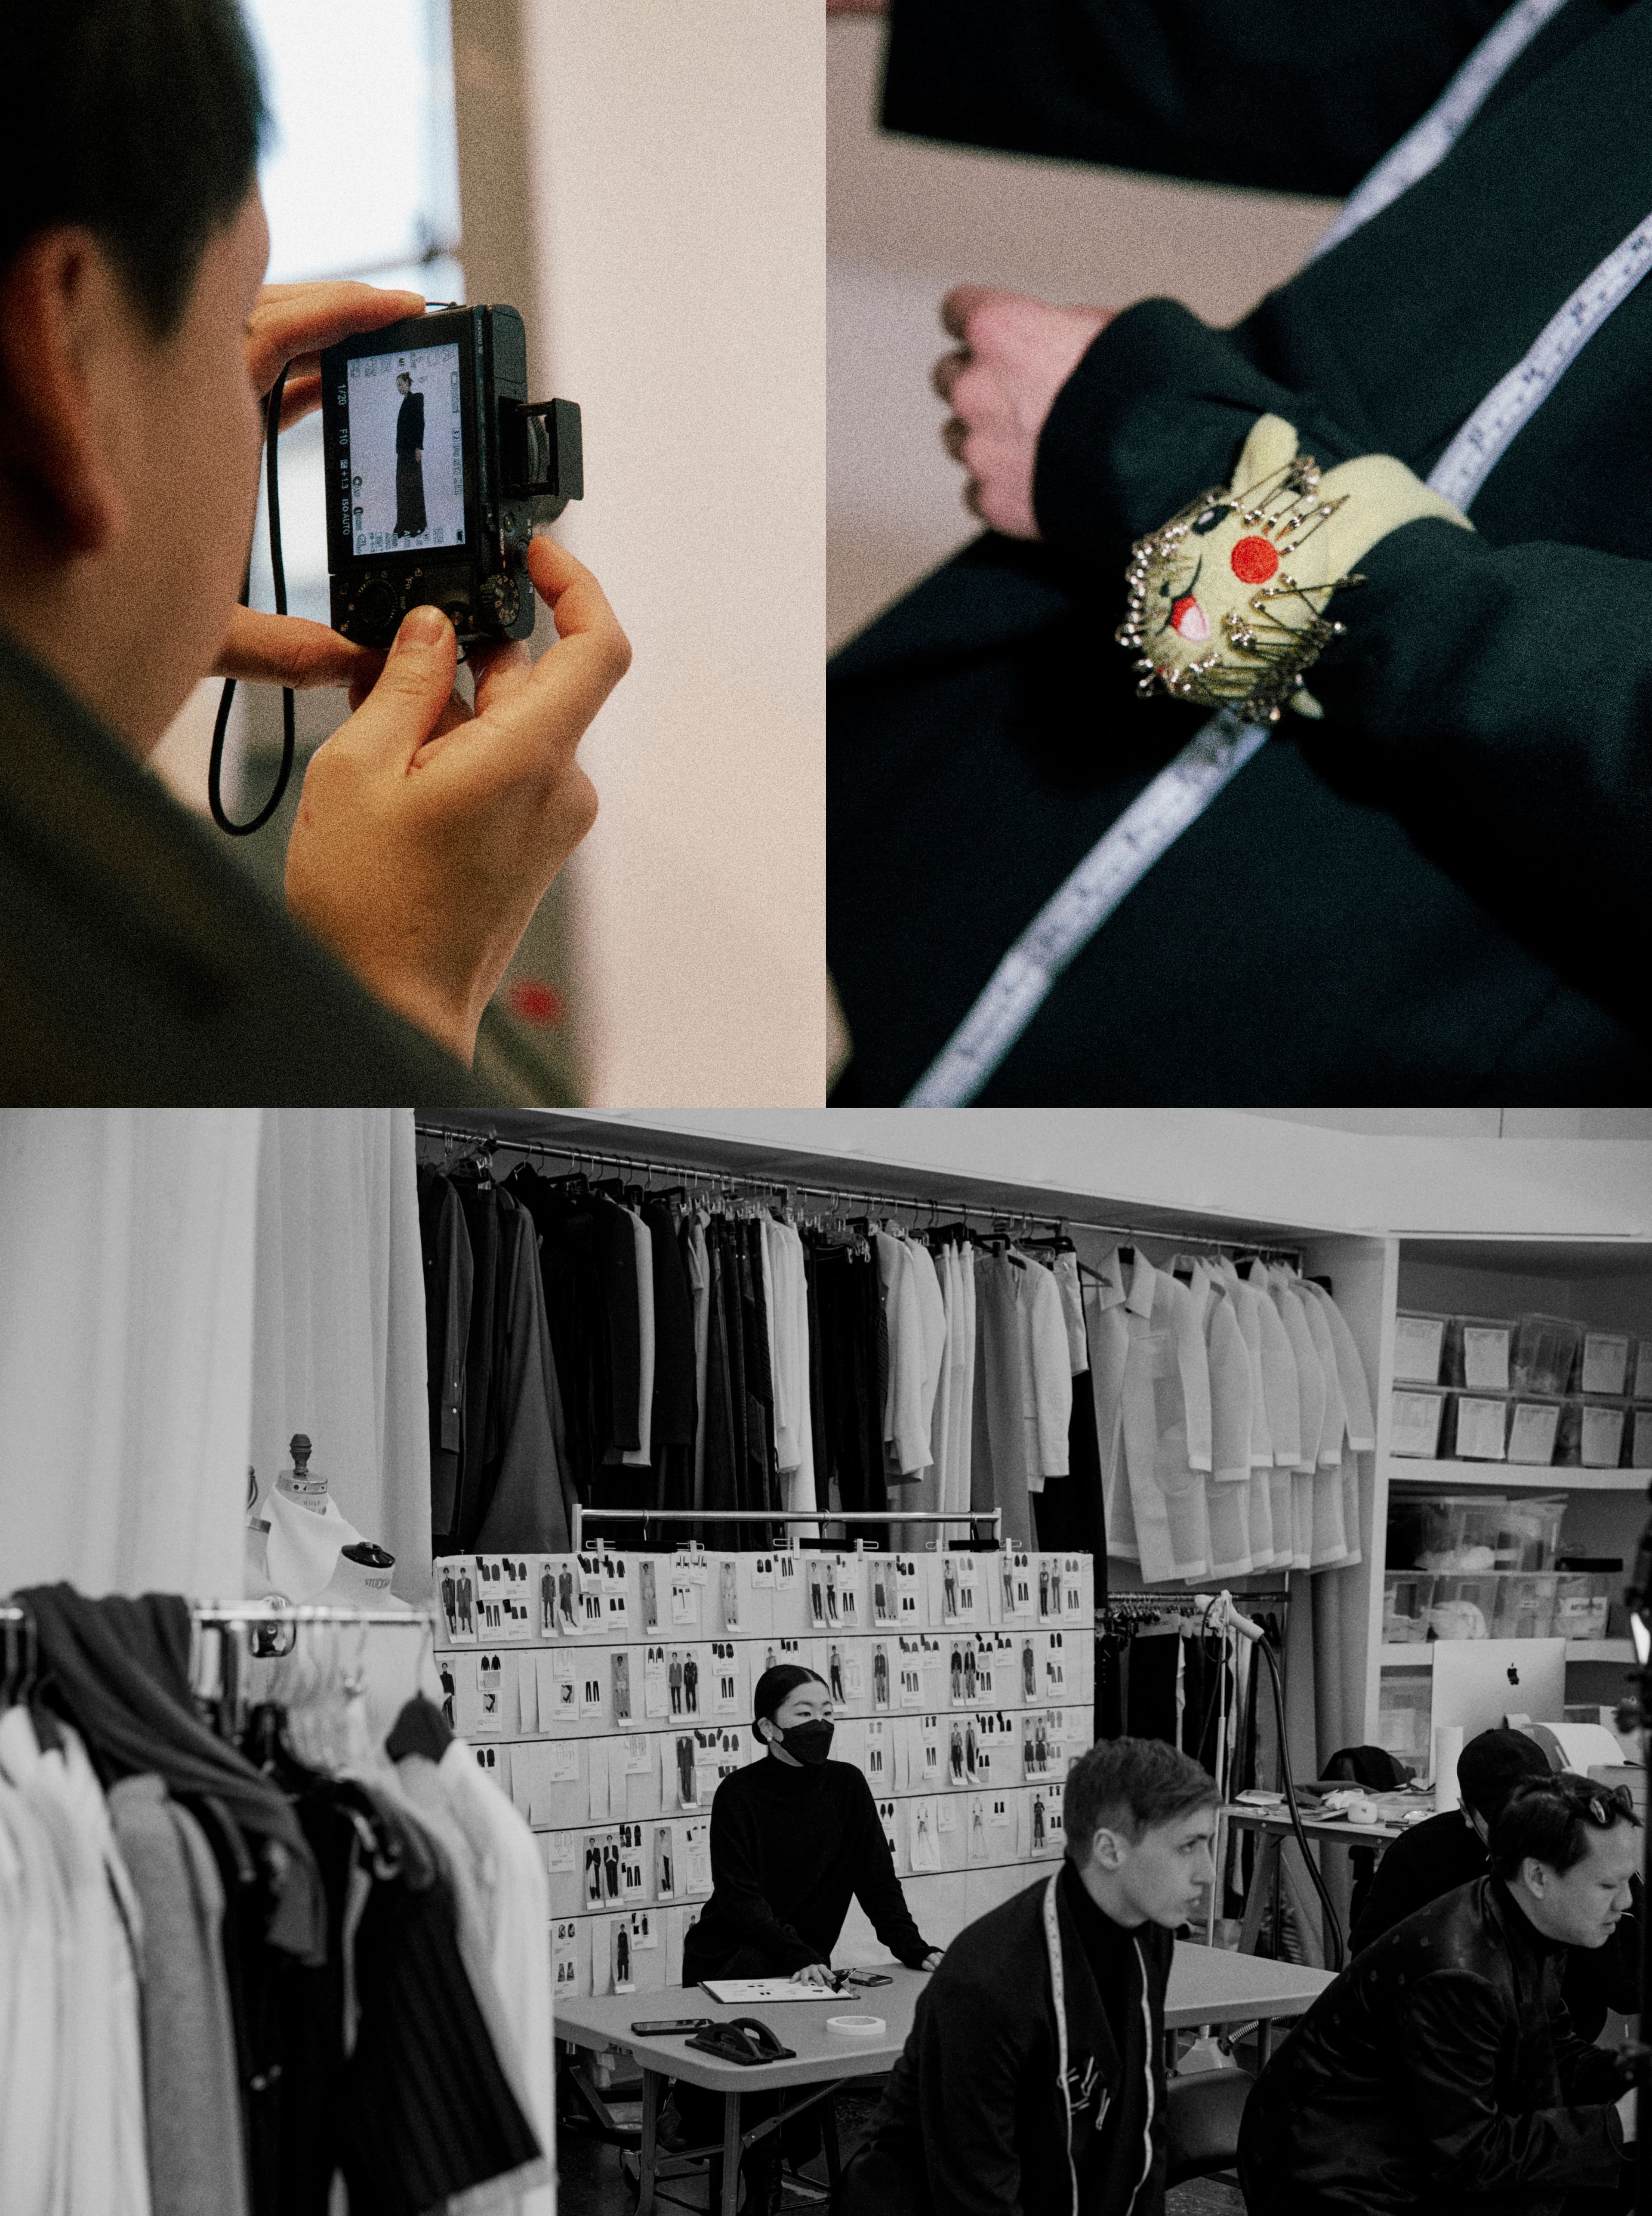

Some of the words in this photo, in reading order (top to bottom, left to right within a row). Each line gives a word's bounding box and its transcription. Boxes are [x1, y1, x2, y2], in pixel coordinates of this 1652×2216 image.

[398, 358, 404, 367] MF
[338, 384, 346, 406] 1/20
[339, 428, 348, 445] F10
[340, 471, 348, 490] +1.3
[405, 578, 412, 589] Fn
